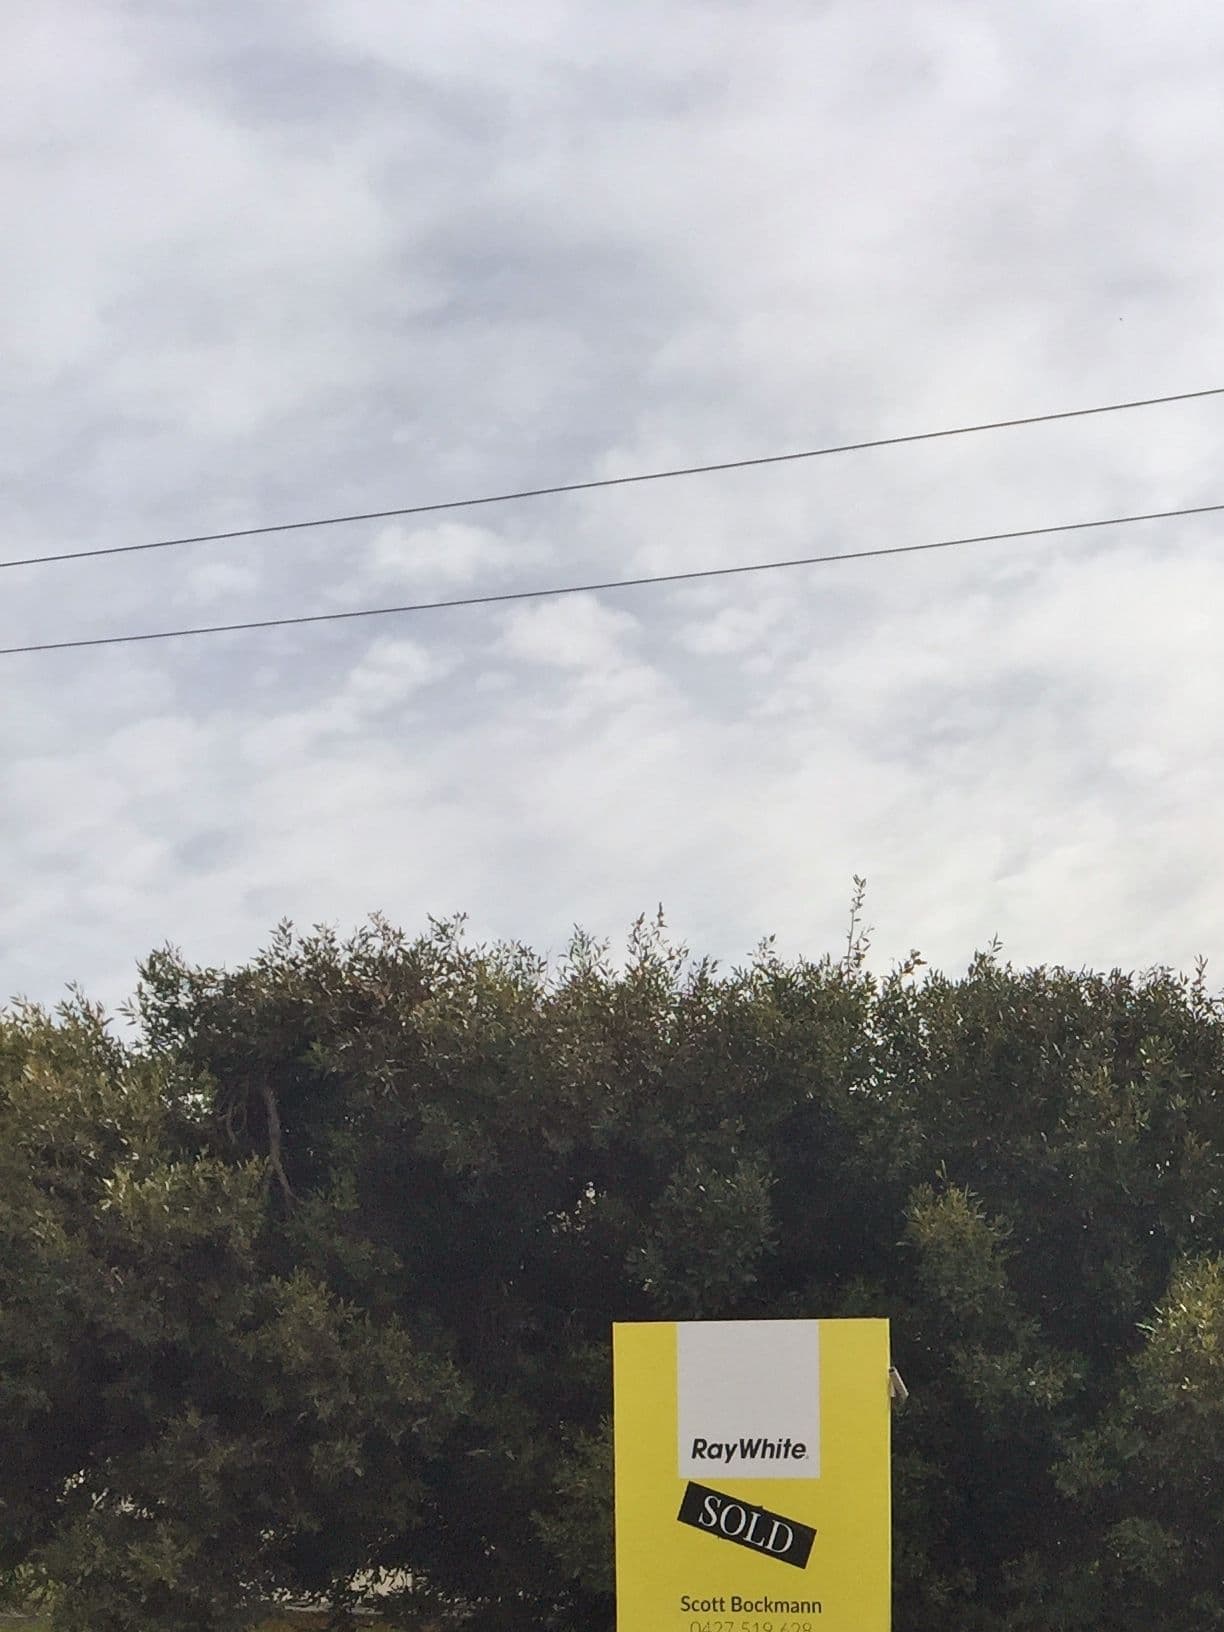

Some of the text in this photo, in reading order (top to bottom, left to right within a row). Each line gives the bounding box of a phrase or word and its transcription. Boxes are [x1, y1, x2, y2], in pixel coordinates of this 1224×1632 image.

[698, 1495, 793, 1554] SOLD
[680, 1595, 822, 1614] Scott Bockmann
